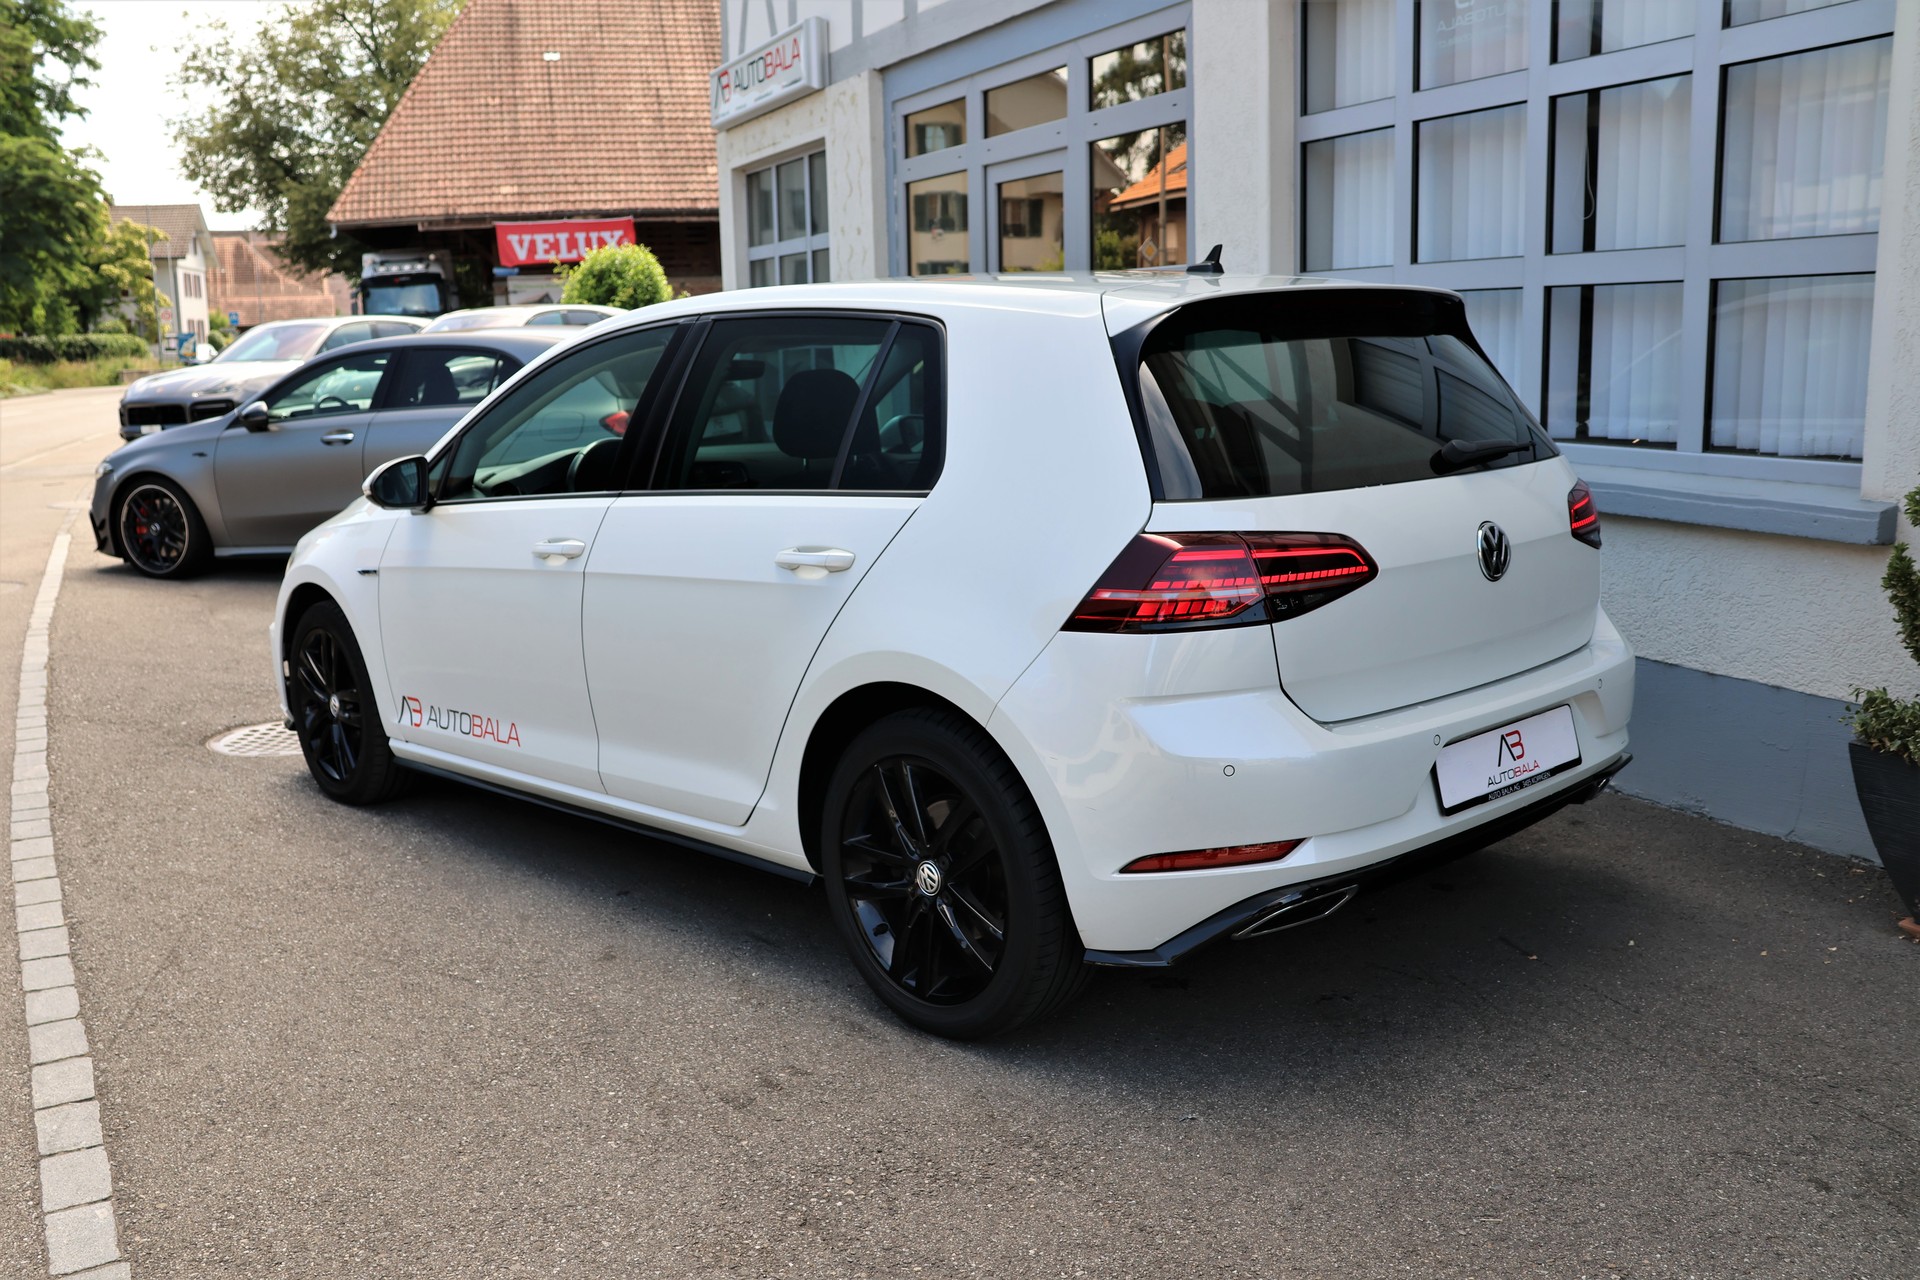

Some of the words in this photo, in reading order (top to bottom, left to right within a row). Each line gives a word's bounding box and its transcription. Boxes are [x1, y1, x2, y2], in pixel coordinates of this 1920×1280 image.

[734, 37, 801, 91] AUTOBALA
[507, 229, 625, 262] VELUX
[427, 705, 521, 748] AUTOBALA
[1487, 759, 1541, 788] AUTOBALA
